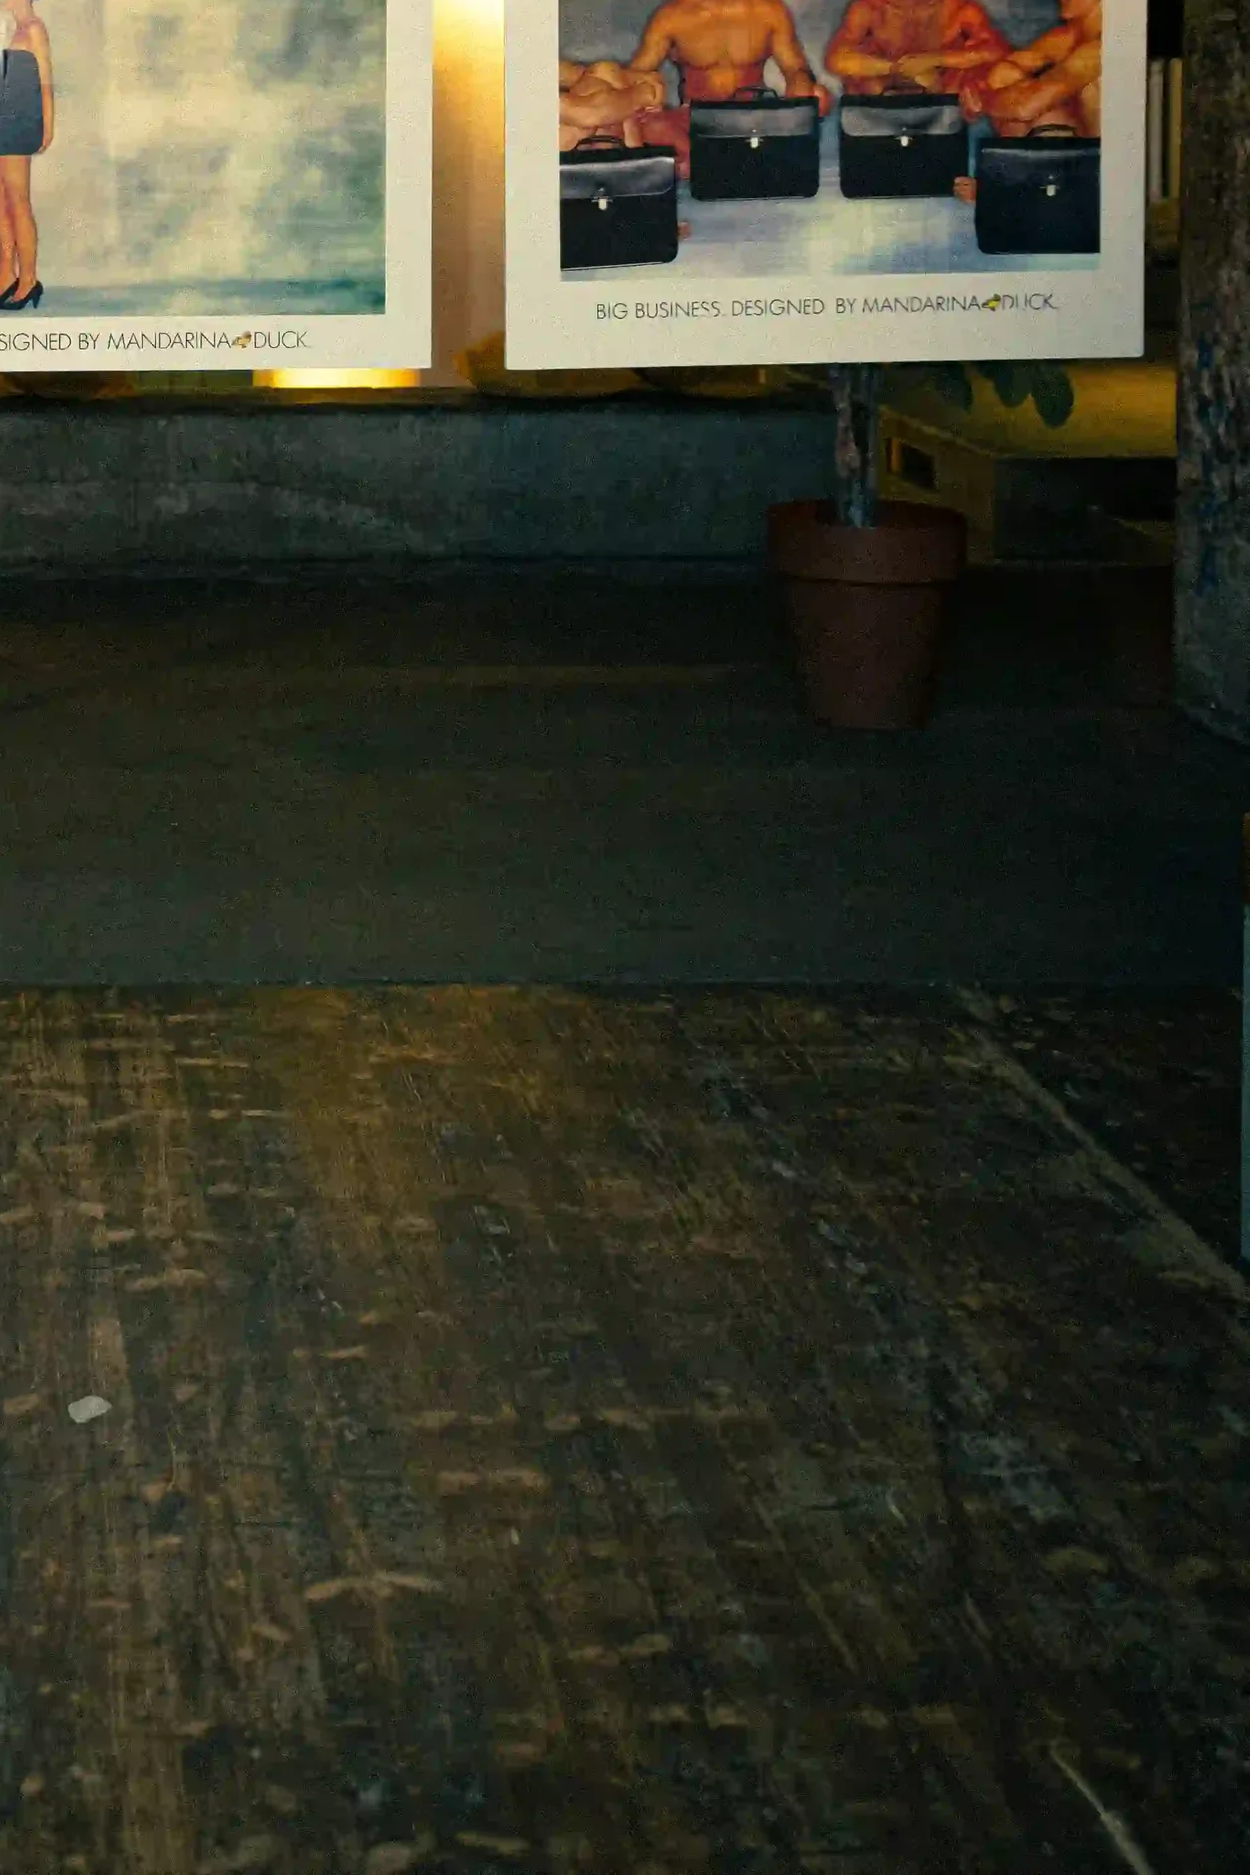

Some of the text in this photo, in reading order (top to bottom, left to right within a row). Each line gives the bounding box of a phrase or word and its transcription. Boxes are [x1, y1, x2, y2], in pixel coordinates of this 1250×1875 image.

[596, 301, 629, 320] BIG
[635, 300, 726, 319] BUSINESS.
[731, 298, 825, 317] DESIGNED
[835, 296, 857, 314] BY
[861, 295, 982, 314] MANDARINA
[78, 332, 101, 351] BY
[107, 332, 232, 350] MANDARINA
